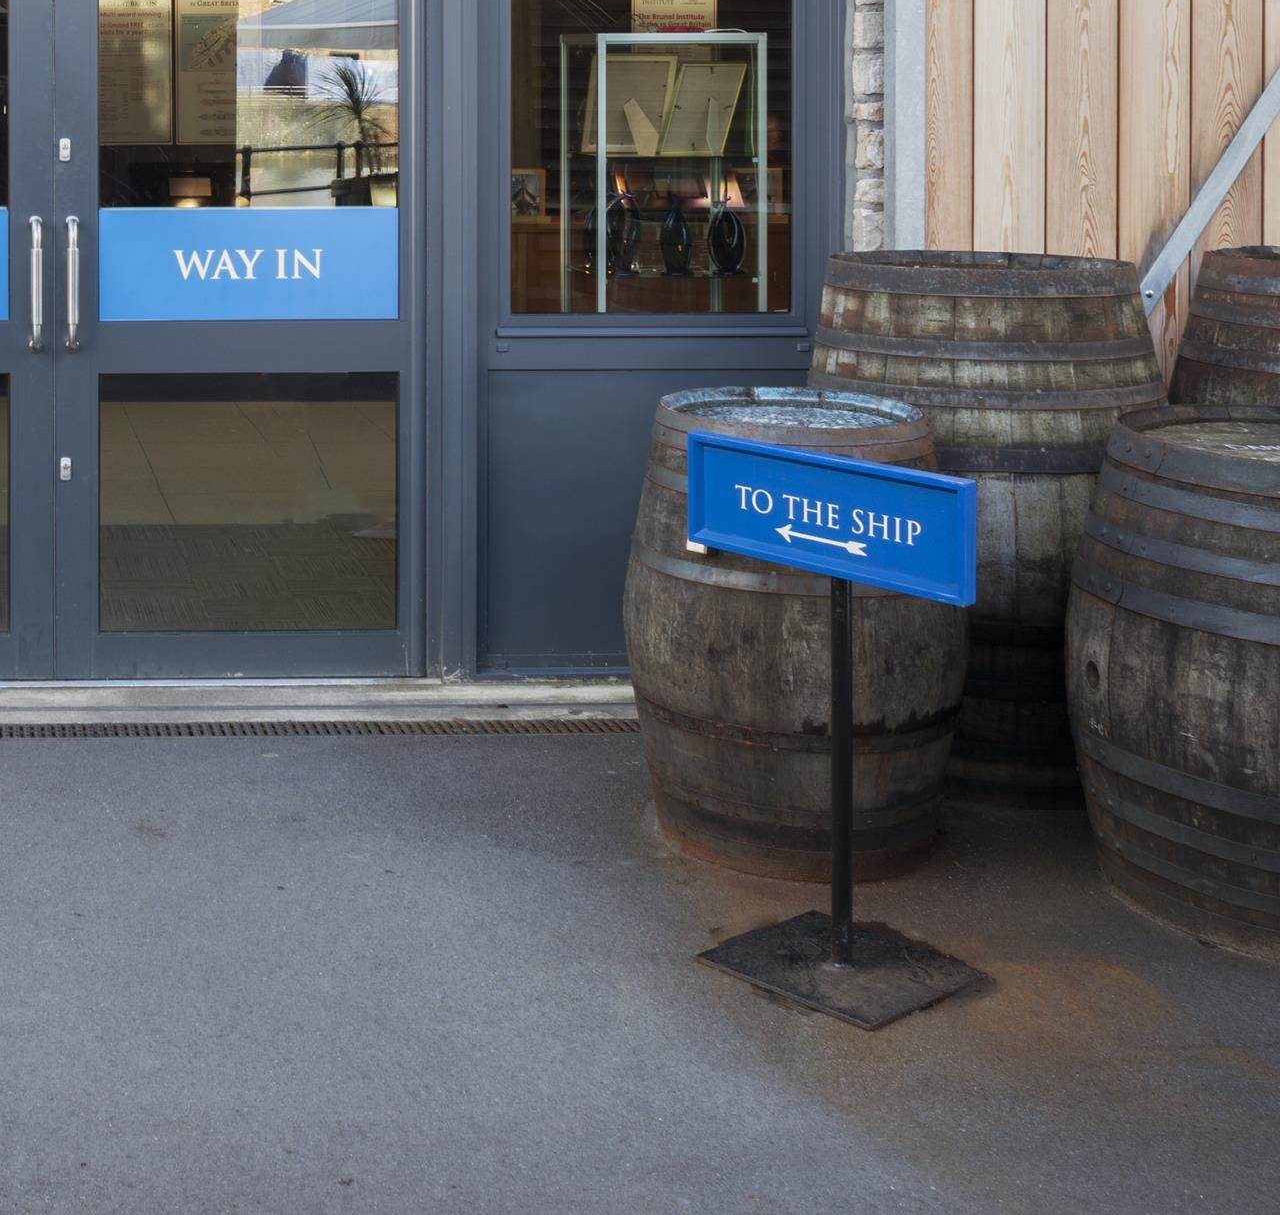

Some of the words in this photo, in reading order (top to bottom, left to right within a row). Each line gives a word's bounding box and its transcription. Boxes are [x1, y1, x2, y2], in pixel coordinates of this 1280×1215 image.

[173, 248, 265, 281] WAY
[275, 248, 323, 281] IN
[734, 483, 773, 514] TO
[782, 494, 840, 530] THE
[851, 507, 922, 546] SHIP
